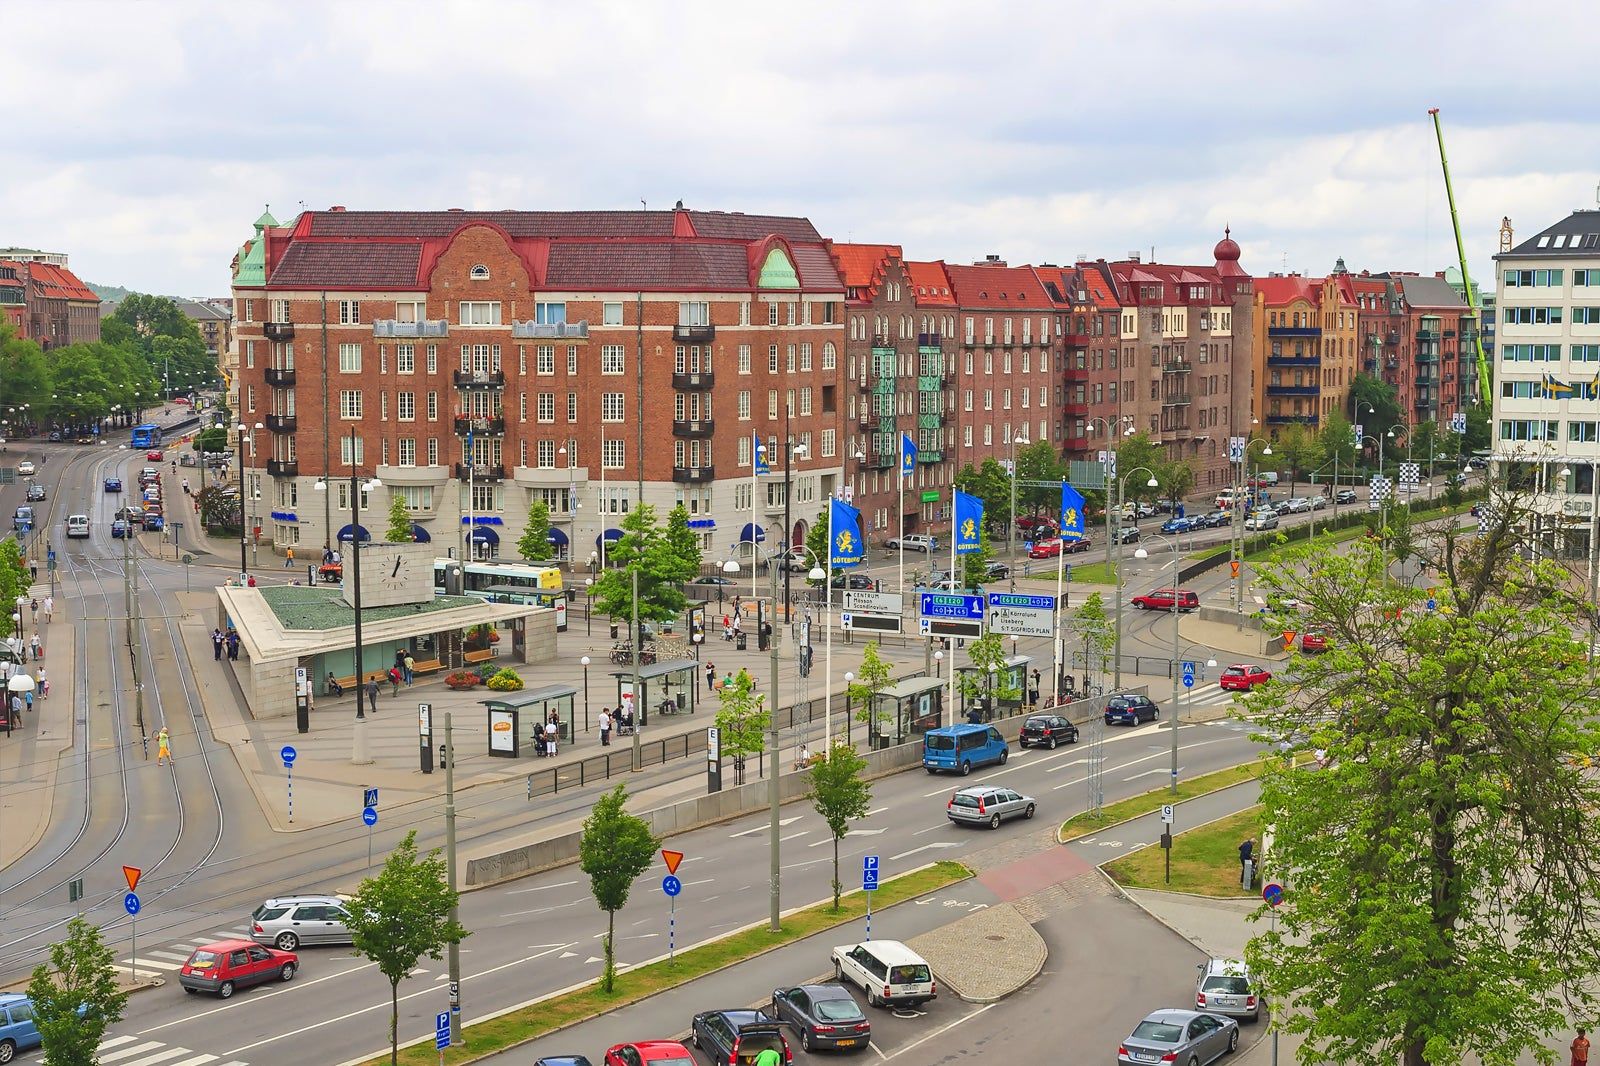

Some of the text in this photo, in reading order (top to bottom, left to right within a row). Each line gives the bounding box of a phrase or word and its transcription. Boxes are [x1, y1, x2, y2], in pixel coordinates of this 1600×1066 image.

[710, 730, 716, 738] E
[1164, 806, 1170, 814] G
[868, 857, 876, 868] P
[440, 1014, 448, 1028] P
